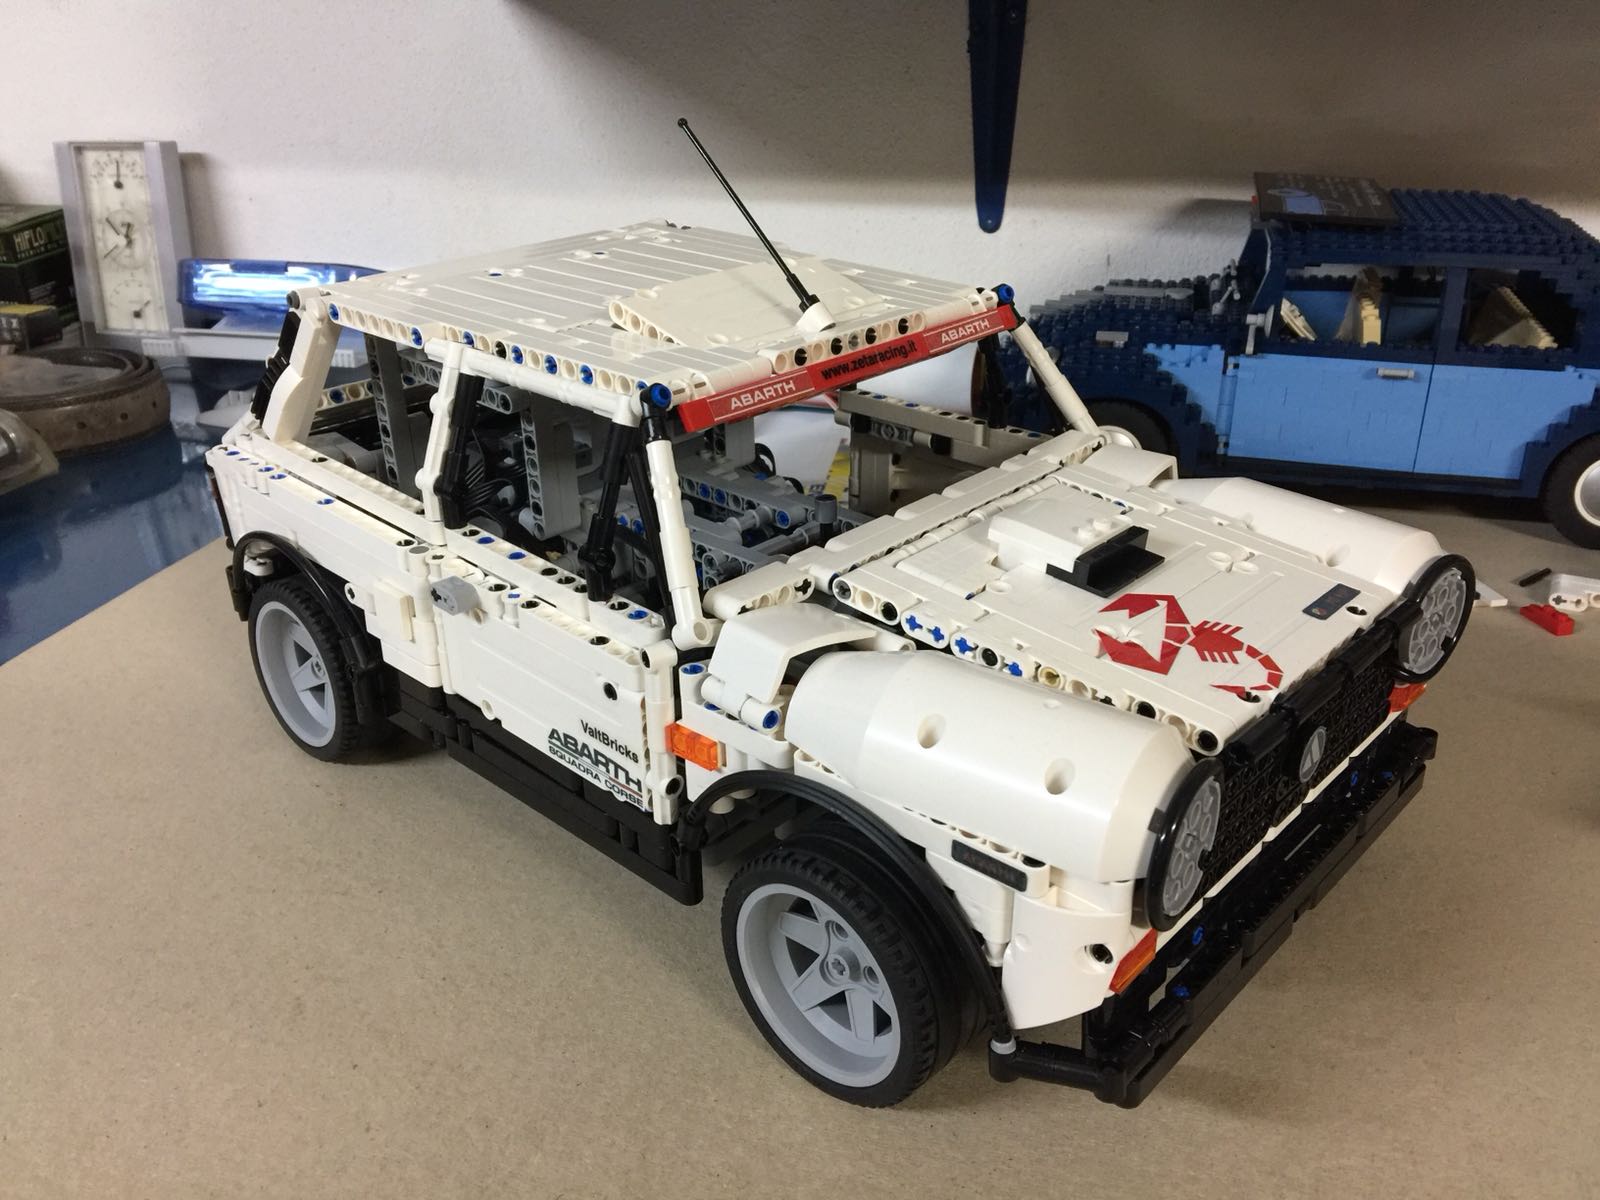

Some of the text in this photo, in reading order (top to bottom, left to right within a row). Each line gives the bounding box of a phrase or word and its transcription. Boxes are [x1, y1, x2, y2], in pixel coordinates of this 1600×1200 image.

[941, 318, 990, 344] ABARTH
[821, 340, 918, 380] www.zetaracing.it
[730, 380, 796, 410] ABARTH
[548, 728, 642, 792] ABARTH
[581, 719, 639, 763] ValtBricks
[549, 746, 602, 783] SQUADRA
